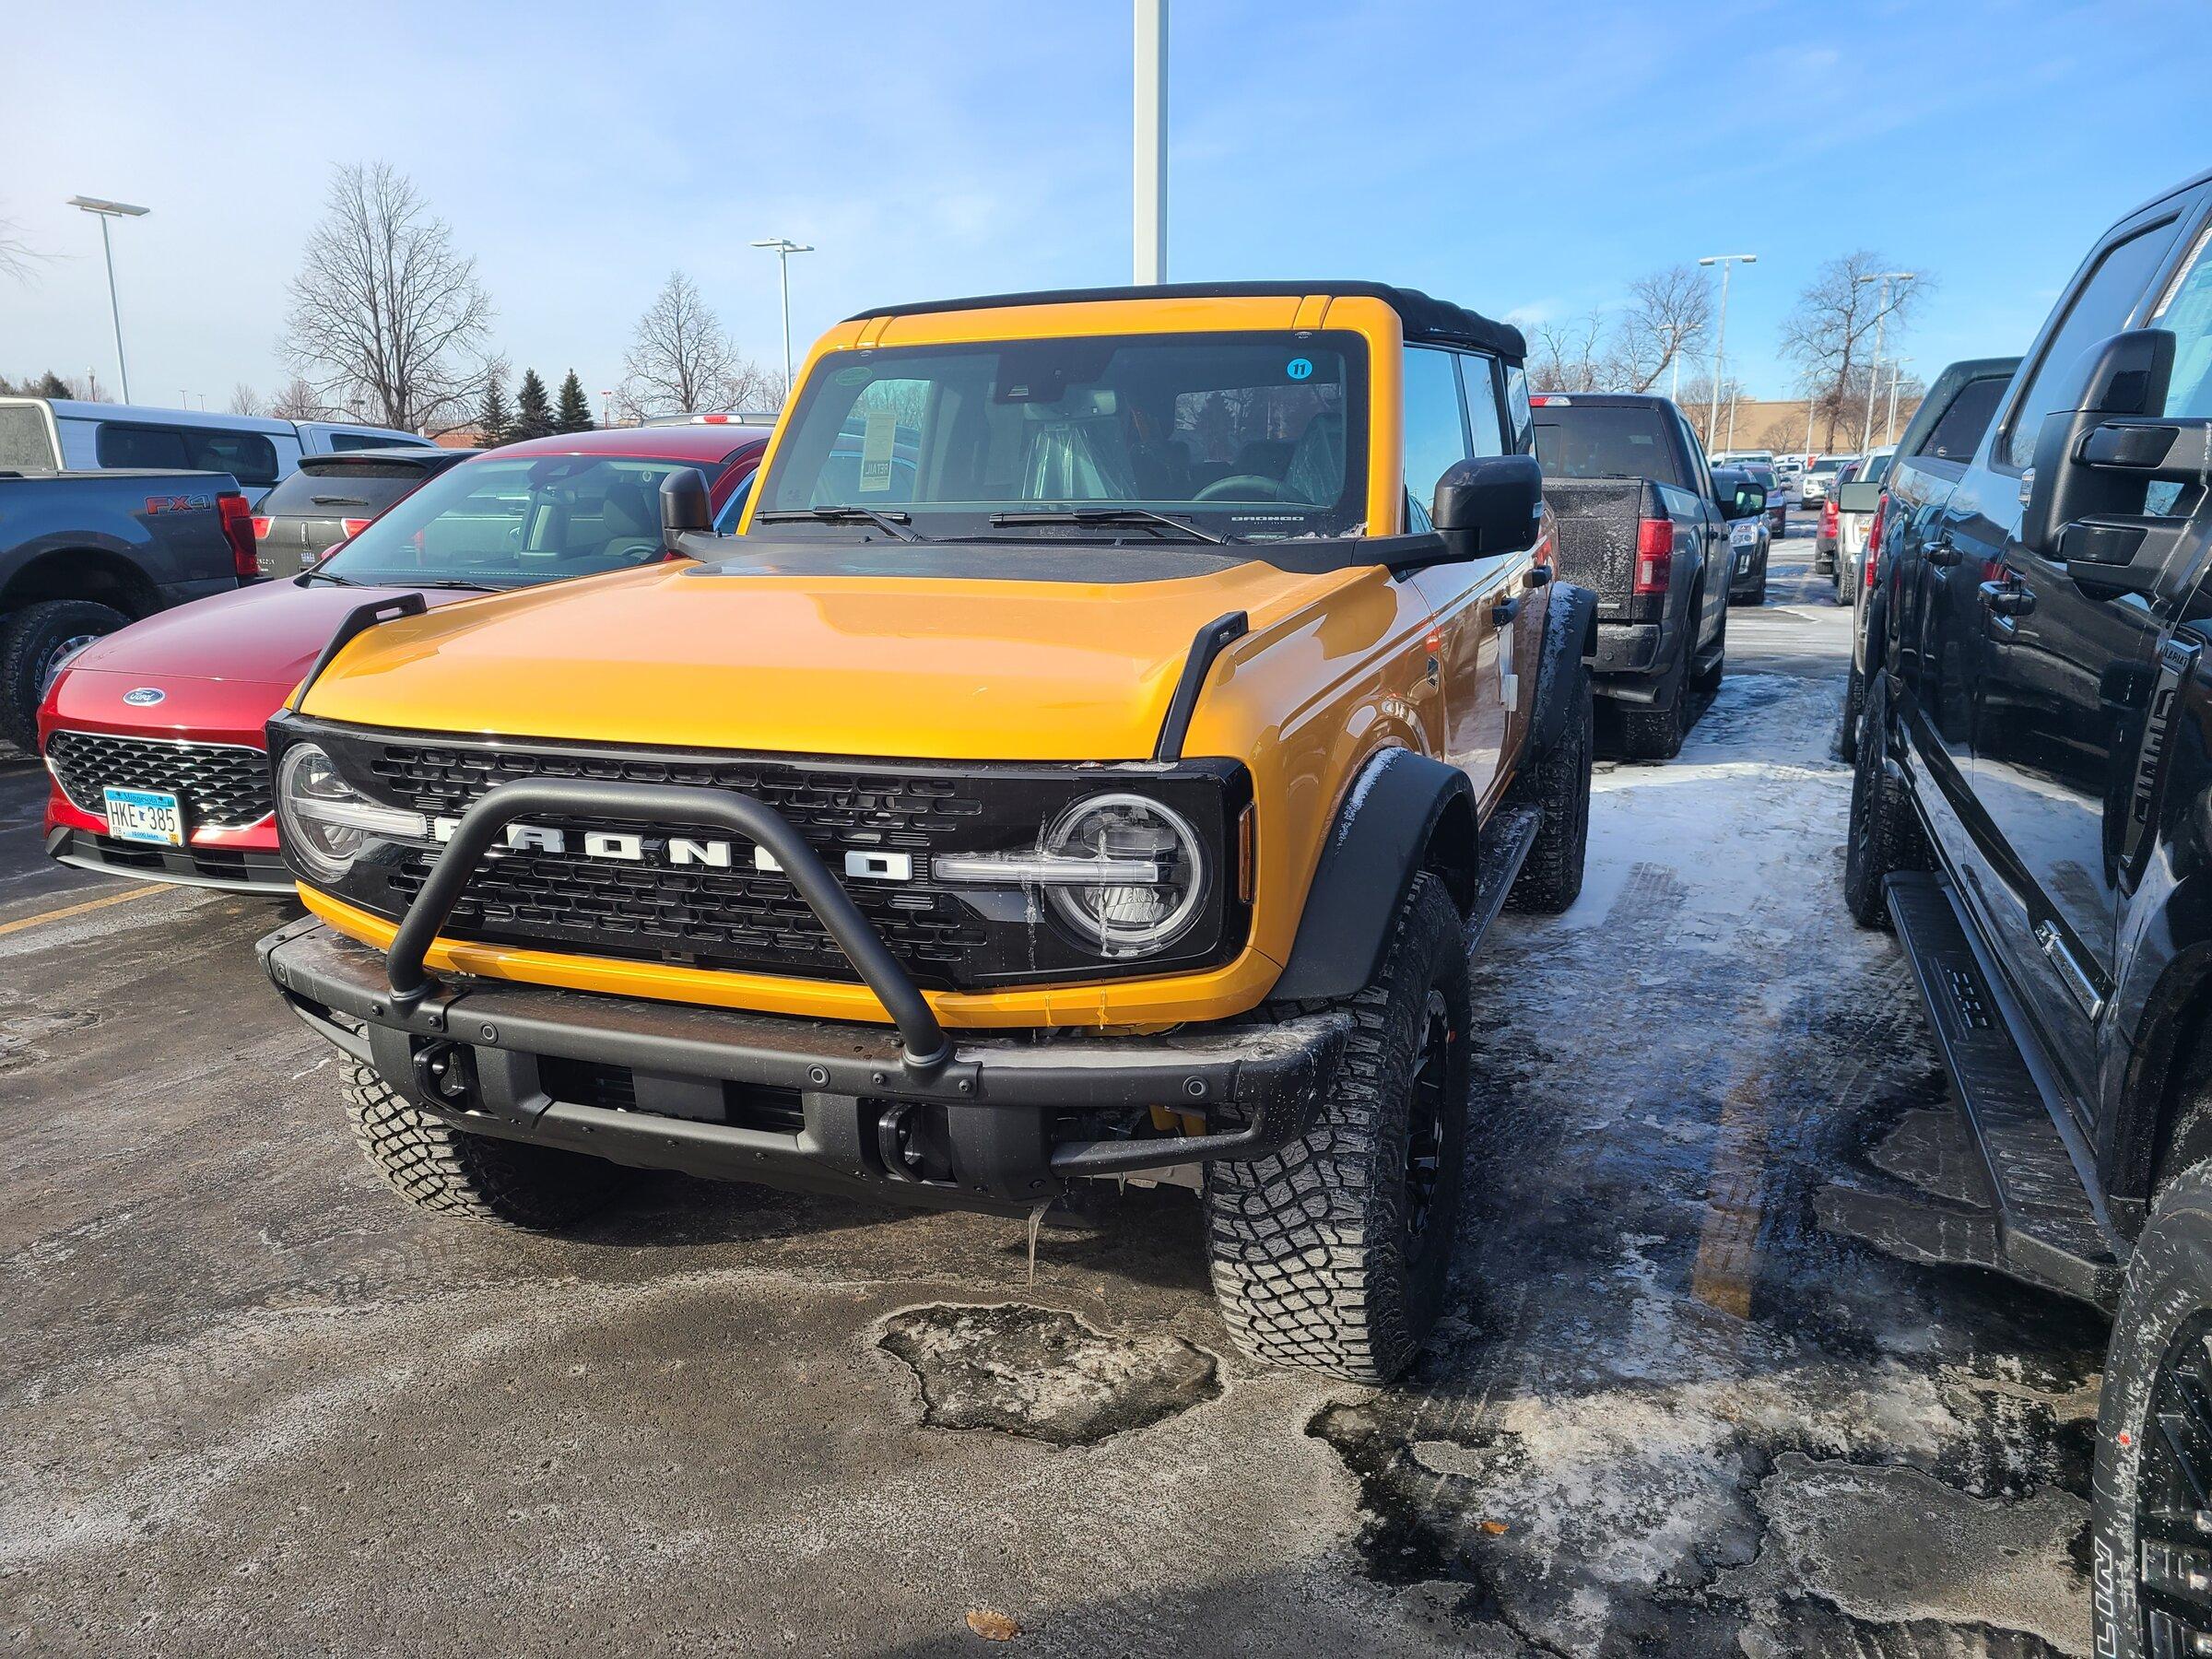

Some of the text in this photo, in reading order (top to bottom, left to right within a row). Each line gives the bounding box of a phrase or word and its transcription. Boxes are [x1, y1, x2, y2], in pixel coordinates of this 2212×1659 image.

[1293, 363, 1306, 376] 11
[145, 494, 211, 516] FX4
[123, 793, 158, 804] Minnesota
[110, 801, 175, 832] HKE 385
[112, 826, 122, 835] FEB
